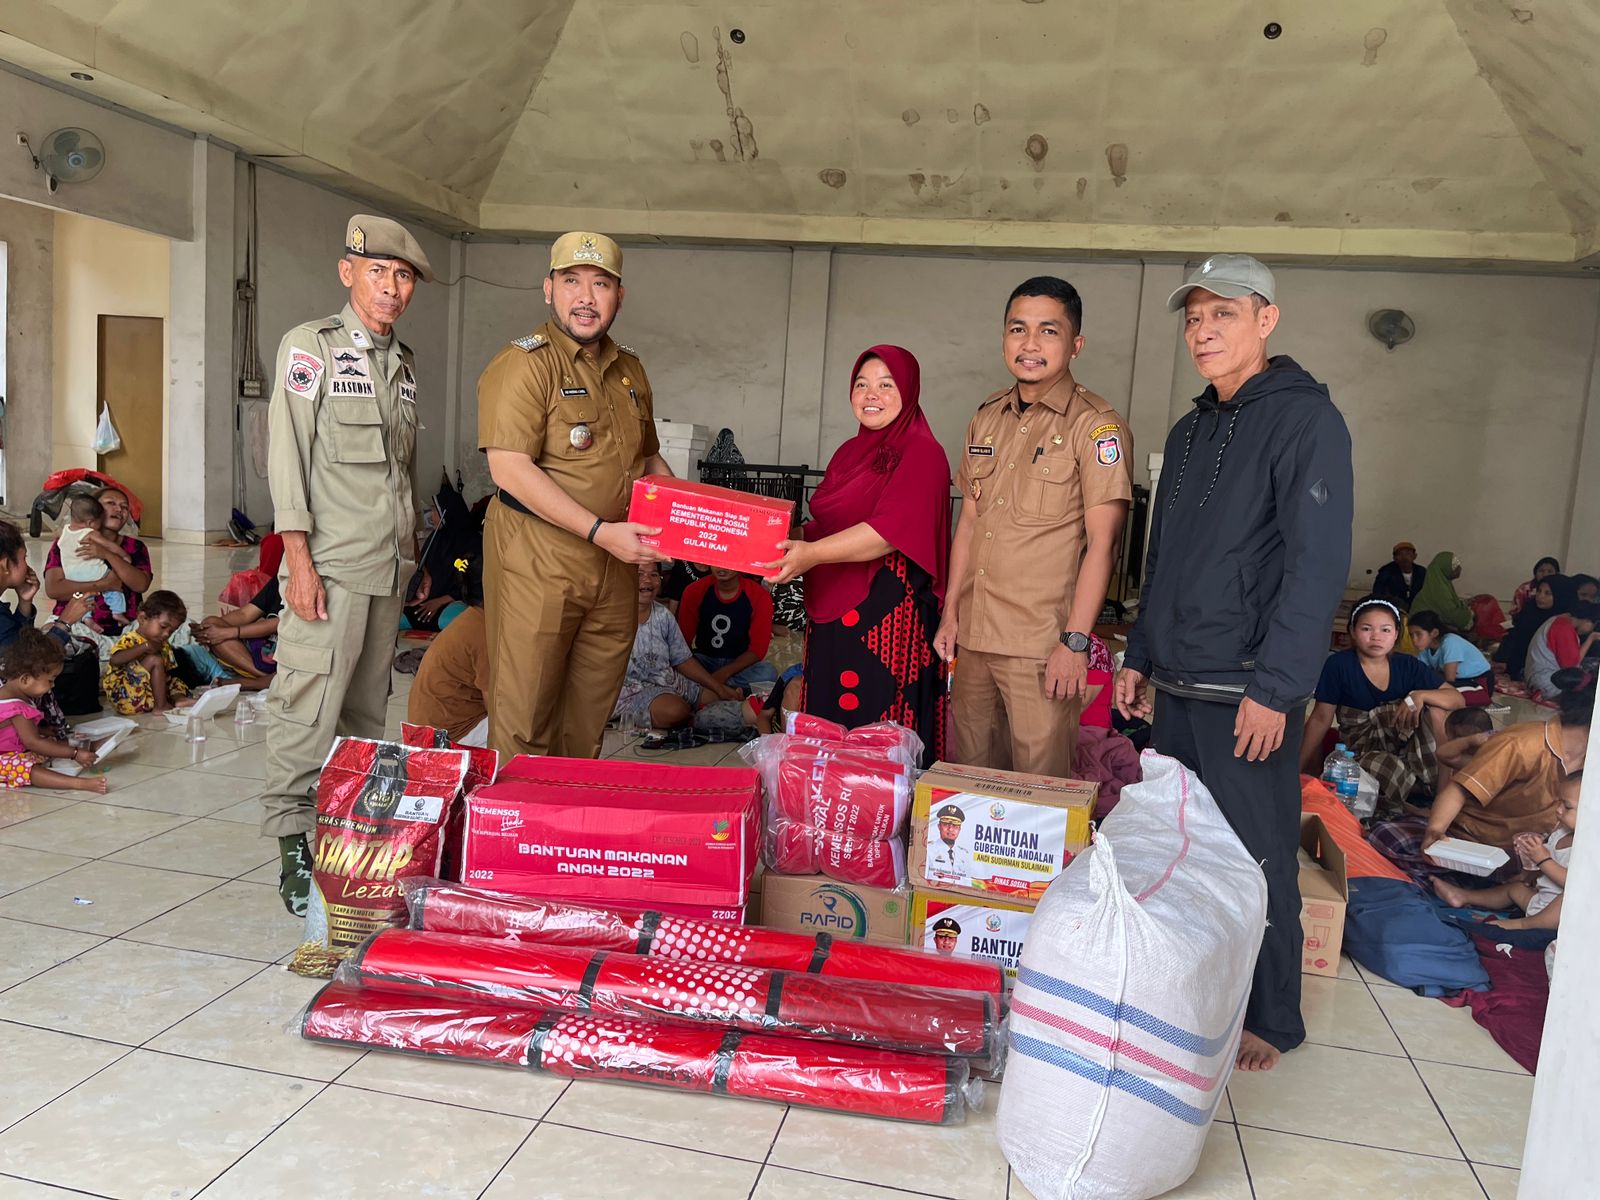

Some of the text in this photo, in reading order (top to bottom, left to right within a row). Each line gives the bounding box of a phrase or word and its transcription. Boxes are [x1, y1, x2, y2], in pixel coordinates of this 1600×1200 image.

[333, 381, 373, 394] RASUDIN
[671, 508, 750, 530] KEMENTERIAN SOSIAL
[672, 501, 697, 512] Bantuan
[697, 506, 724, 517] Makanan
[725, 511, 738, 520] Siap
[669, 516, 748, 537] REPUBLIK INDONESIA
[683, 537, 728, 552] GULAI IKAN
[698, 531, 718, 541] 2022
[839, 787, 852, 805] RI
[849, 804, 860, 825] 2022
[339, 819, 377, 834] PREMIUM
[975, 824, 1039, 850] BANTUAN
[315, 832, 413, 881] SANTAP
[518, 843, 688, 866] BANTUAN MAKANAN
[974, 842, 1054, 864] GUBERNUR ANDALAN
[557, 862, 655, 878] ANAK 2022
[976, 853, 1050, 873] ANDI SUDIRMAN SULAIMAN
[469, 870, 494, 880] 2022
[993, 877, 1028, 889] DINAS SOSIAL
[333, 906, 351, 914] TANPA
[712, 910, 737, 920] 2022
[335, 919, 352, 927] TANPA
[800, 912, 854, 929] RAPID
[335, 932, 352, 940] TANPA
[971, 936, 1024, 958] BANTUA
